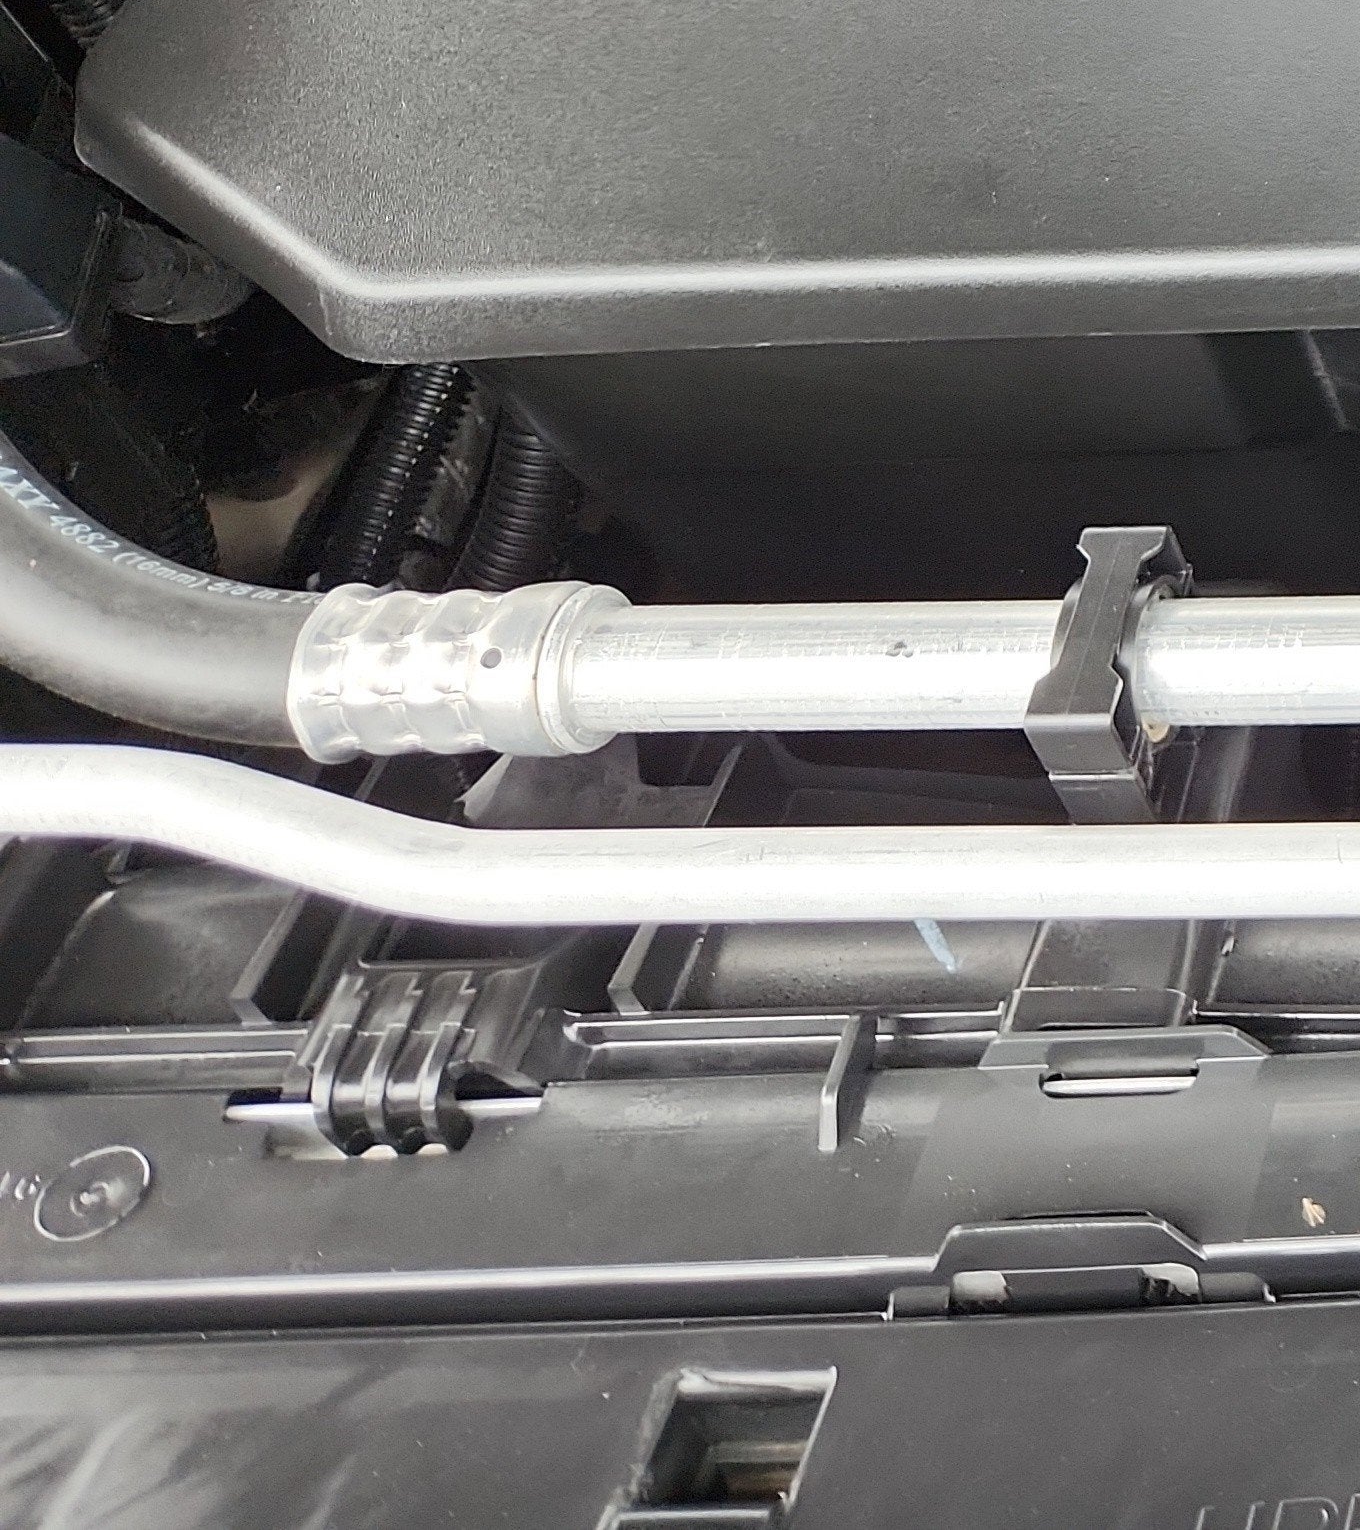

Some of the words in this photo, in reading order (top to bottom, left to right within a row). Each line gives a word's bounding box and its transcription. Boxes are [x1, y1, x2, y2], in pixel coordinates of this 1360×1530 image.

[0, 455, 60, 510] AXY
[50, 515, 120, 553] 4882
[111, 551, 210, 589] (16mm)
